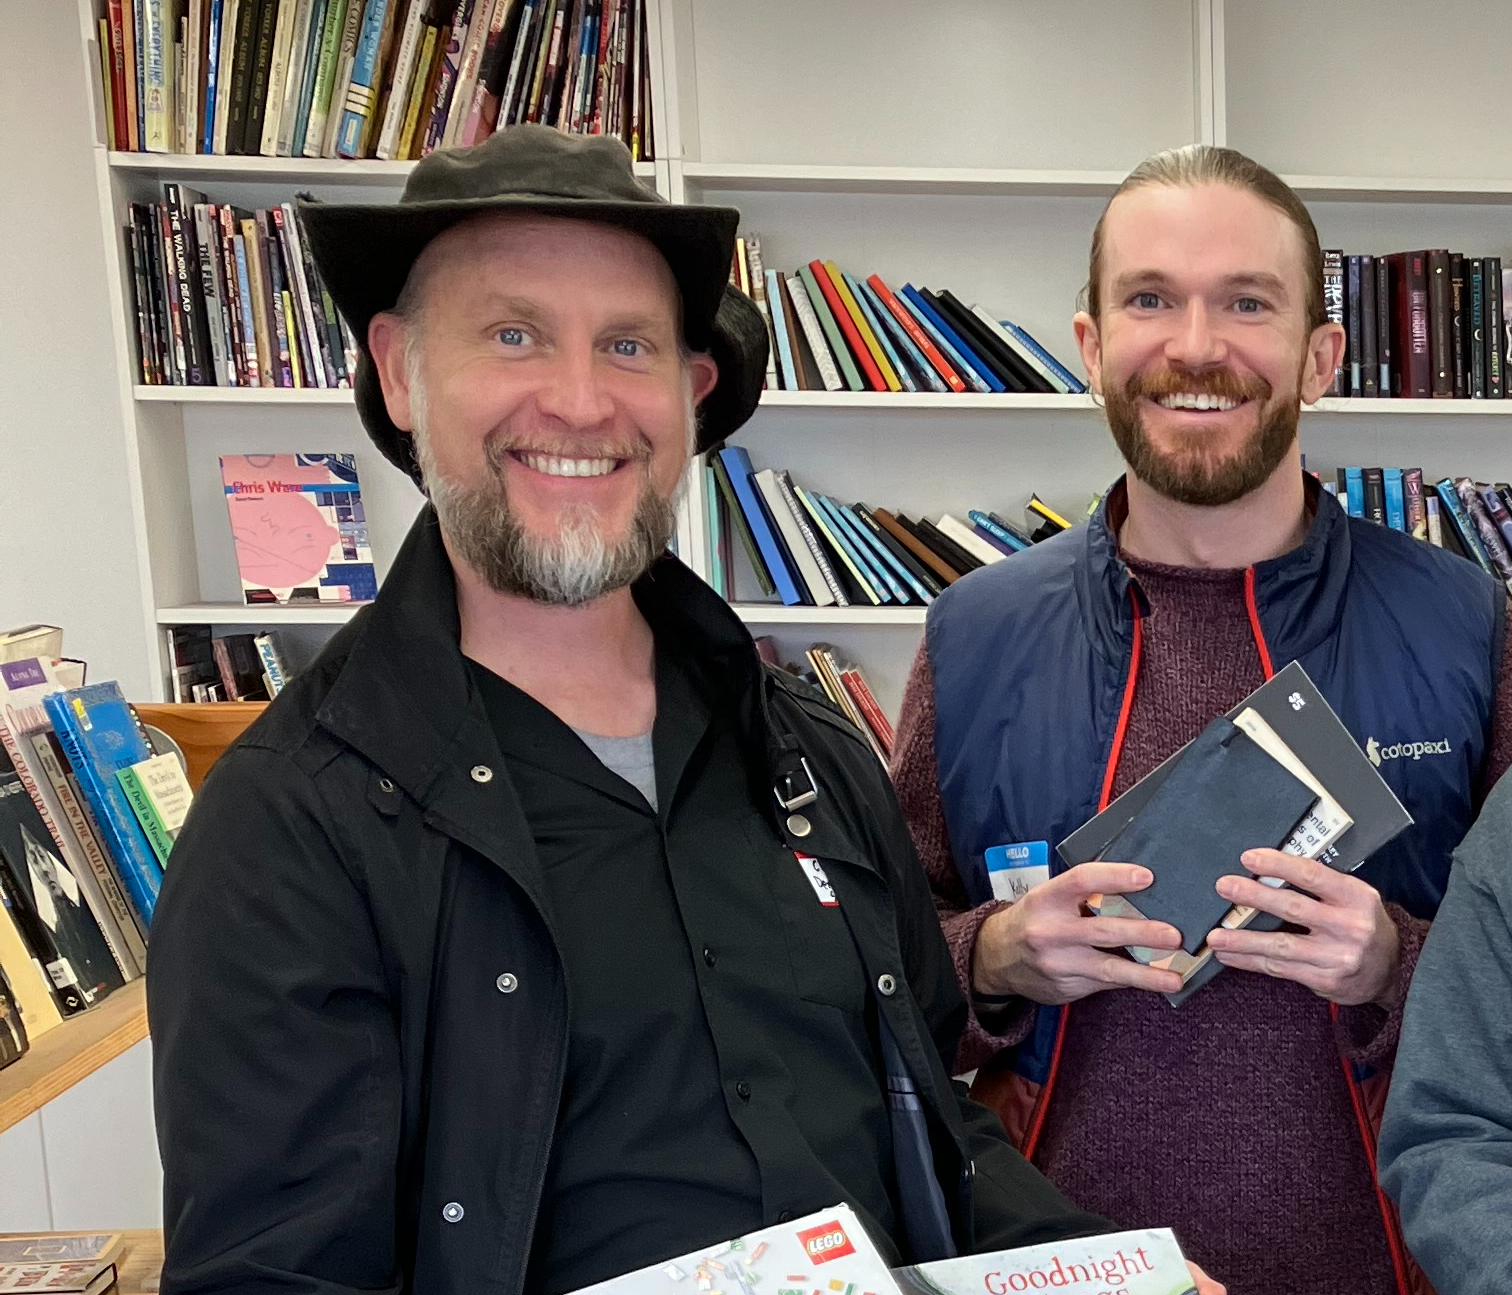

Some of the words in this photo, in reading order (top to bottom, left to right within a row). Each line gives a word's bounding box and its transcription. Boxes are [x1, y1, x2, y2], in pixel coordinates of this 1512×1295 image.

[344, 6, 361, 53] COMICS
[365, 29, 381, 70] WOMAN
[170, 210, 180, 229] THE
[173, 233, 189, 281] WALKING
[181, 283, 193, 313] DEAD
[232, 481, 264, 495] Chris
[267, 480, 303, 493] Ware
[1380, 737, 1452, 760] cotopaxi
[0, 726, 14, 753] THE
[11, 752, 49, 818] COLORADO
[123, 774, 134, 791] The
[131, 789, 148, 814] Devil
[58, 784, 72, 804] FIRE
[75, 820, 91, 840] THE
[86, 841, 108, 876] VALLEY
[1307, 832, 1321, 847] of
[1005, 846, 1030, 860] HELLO
[809, 1231, 845, 1254] LEGO
